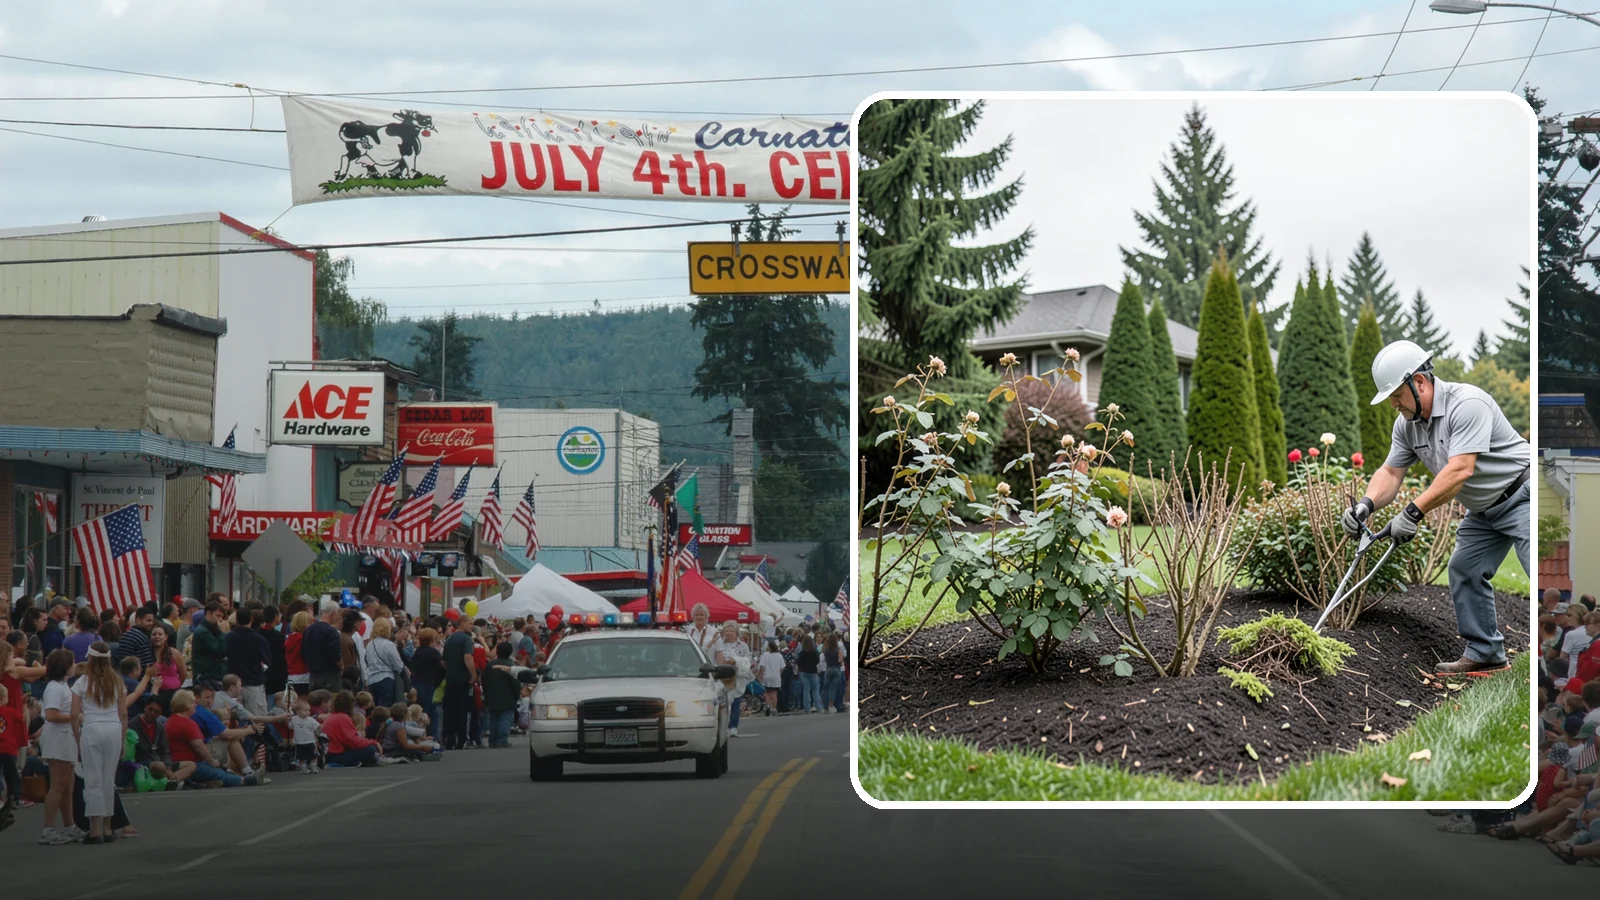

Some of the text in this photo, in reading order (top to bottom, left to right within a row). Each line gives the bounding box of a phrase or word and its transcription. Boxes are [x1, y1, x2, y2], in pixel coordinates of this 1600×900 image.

[695, 122, 850, 149] Carnat
[481, 141, 604, 192] JULY
[632, 150, 746, 198] 4th.
[697, 254, 850, 280] CROSSWA
[283, 380, 373, 420] ACE
[406, 409, 485, 422] CEDAR LOG
[283, 421, 370, 436] Hardware
[353, 467, 384, 480] Simpl
[95, 485, 124, 494] Vincent
[126, 486, 135, 495] de
[138, 486, 155, 495] Paul
[80, 503, 153, 521] THT
[688, 526, 741, 535] CRNATION
[699, 535, 730, 543] GLASS
